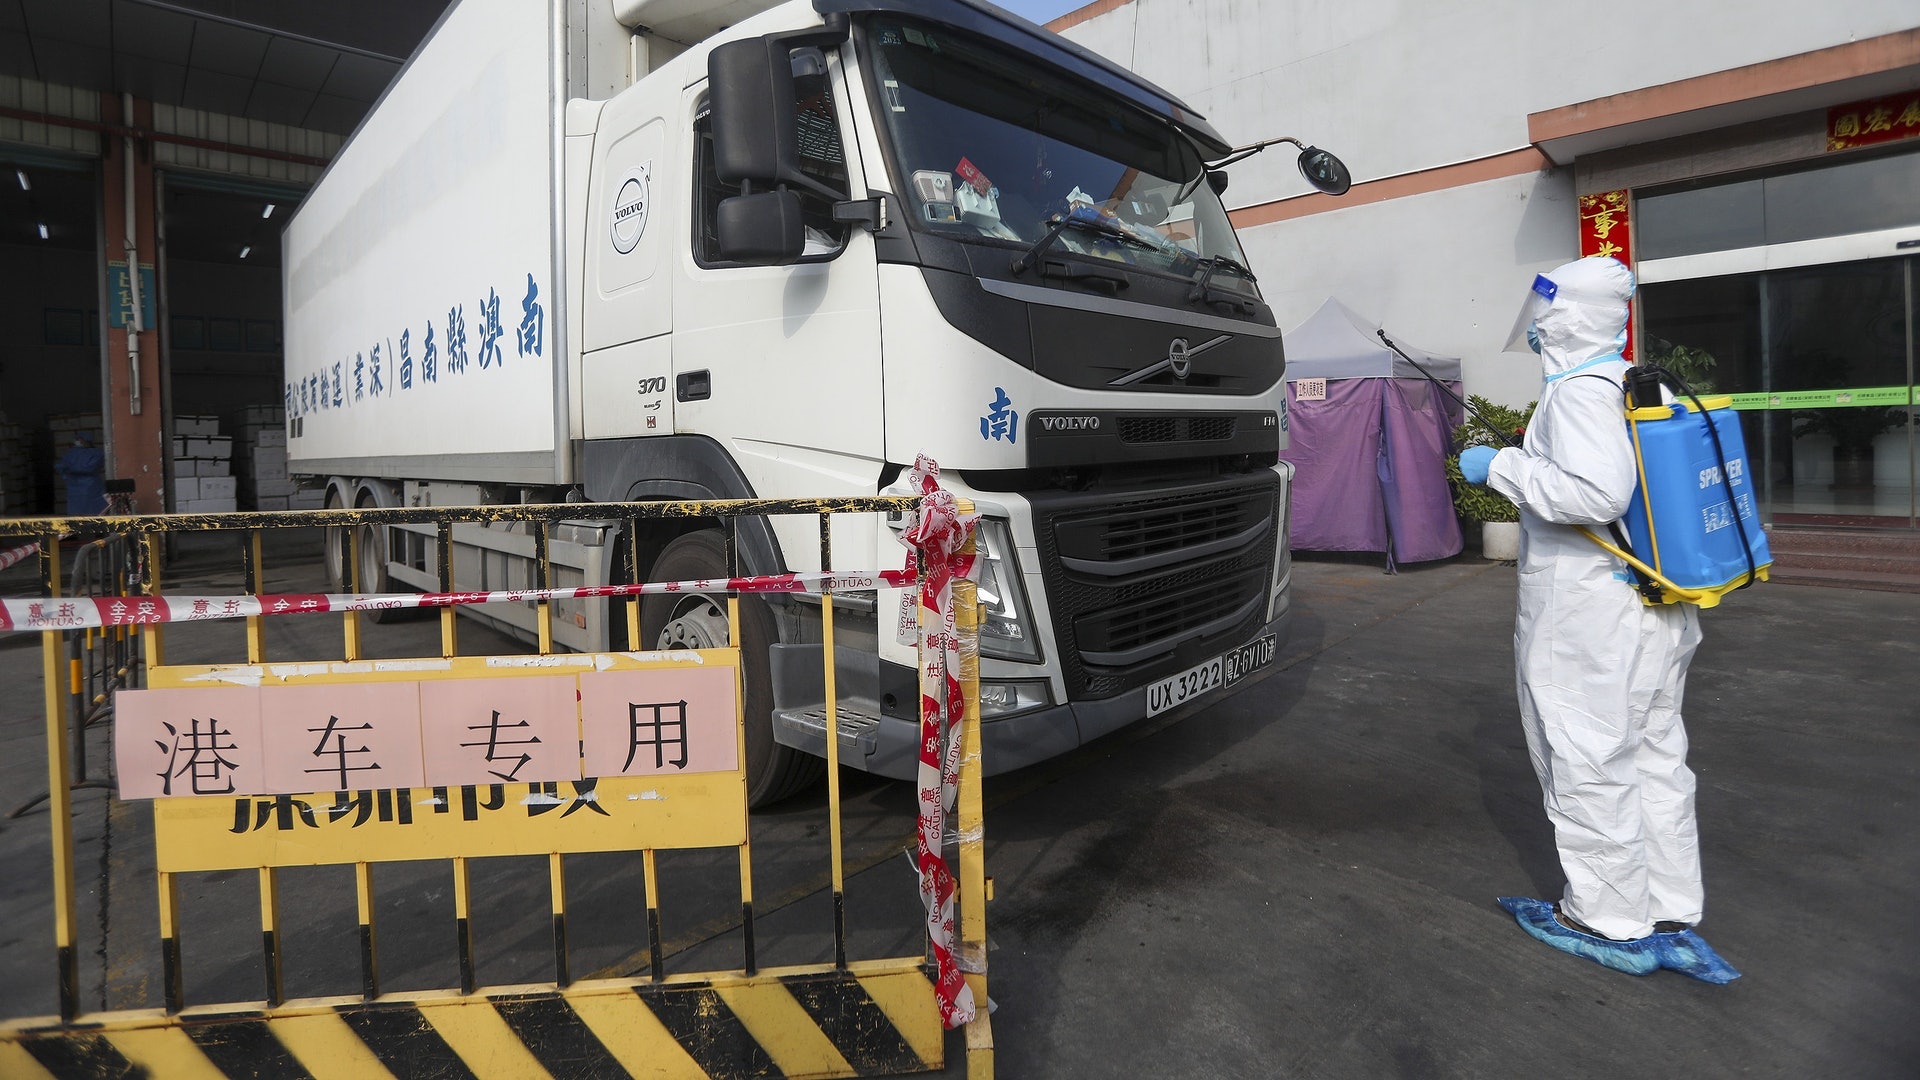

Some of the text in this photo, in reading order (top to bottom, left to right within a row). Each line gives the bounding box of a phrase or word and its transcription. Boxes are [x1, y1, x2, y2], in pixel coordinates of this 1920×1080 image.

[614, 200, 643, 220] VOLVO
[637, 376, 666, 394] 370
[979, 387, 1018, 444] 南
[1039, 416, 1100, 430] VOLVO
[1150, 661, 1220, 712] UX 3222
[154, 699, 689, 796] 港车专用
